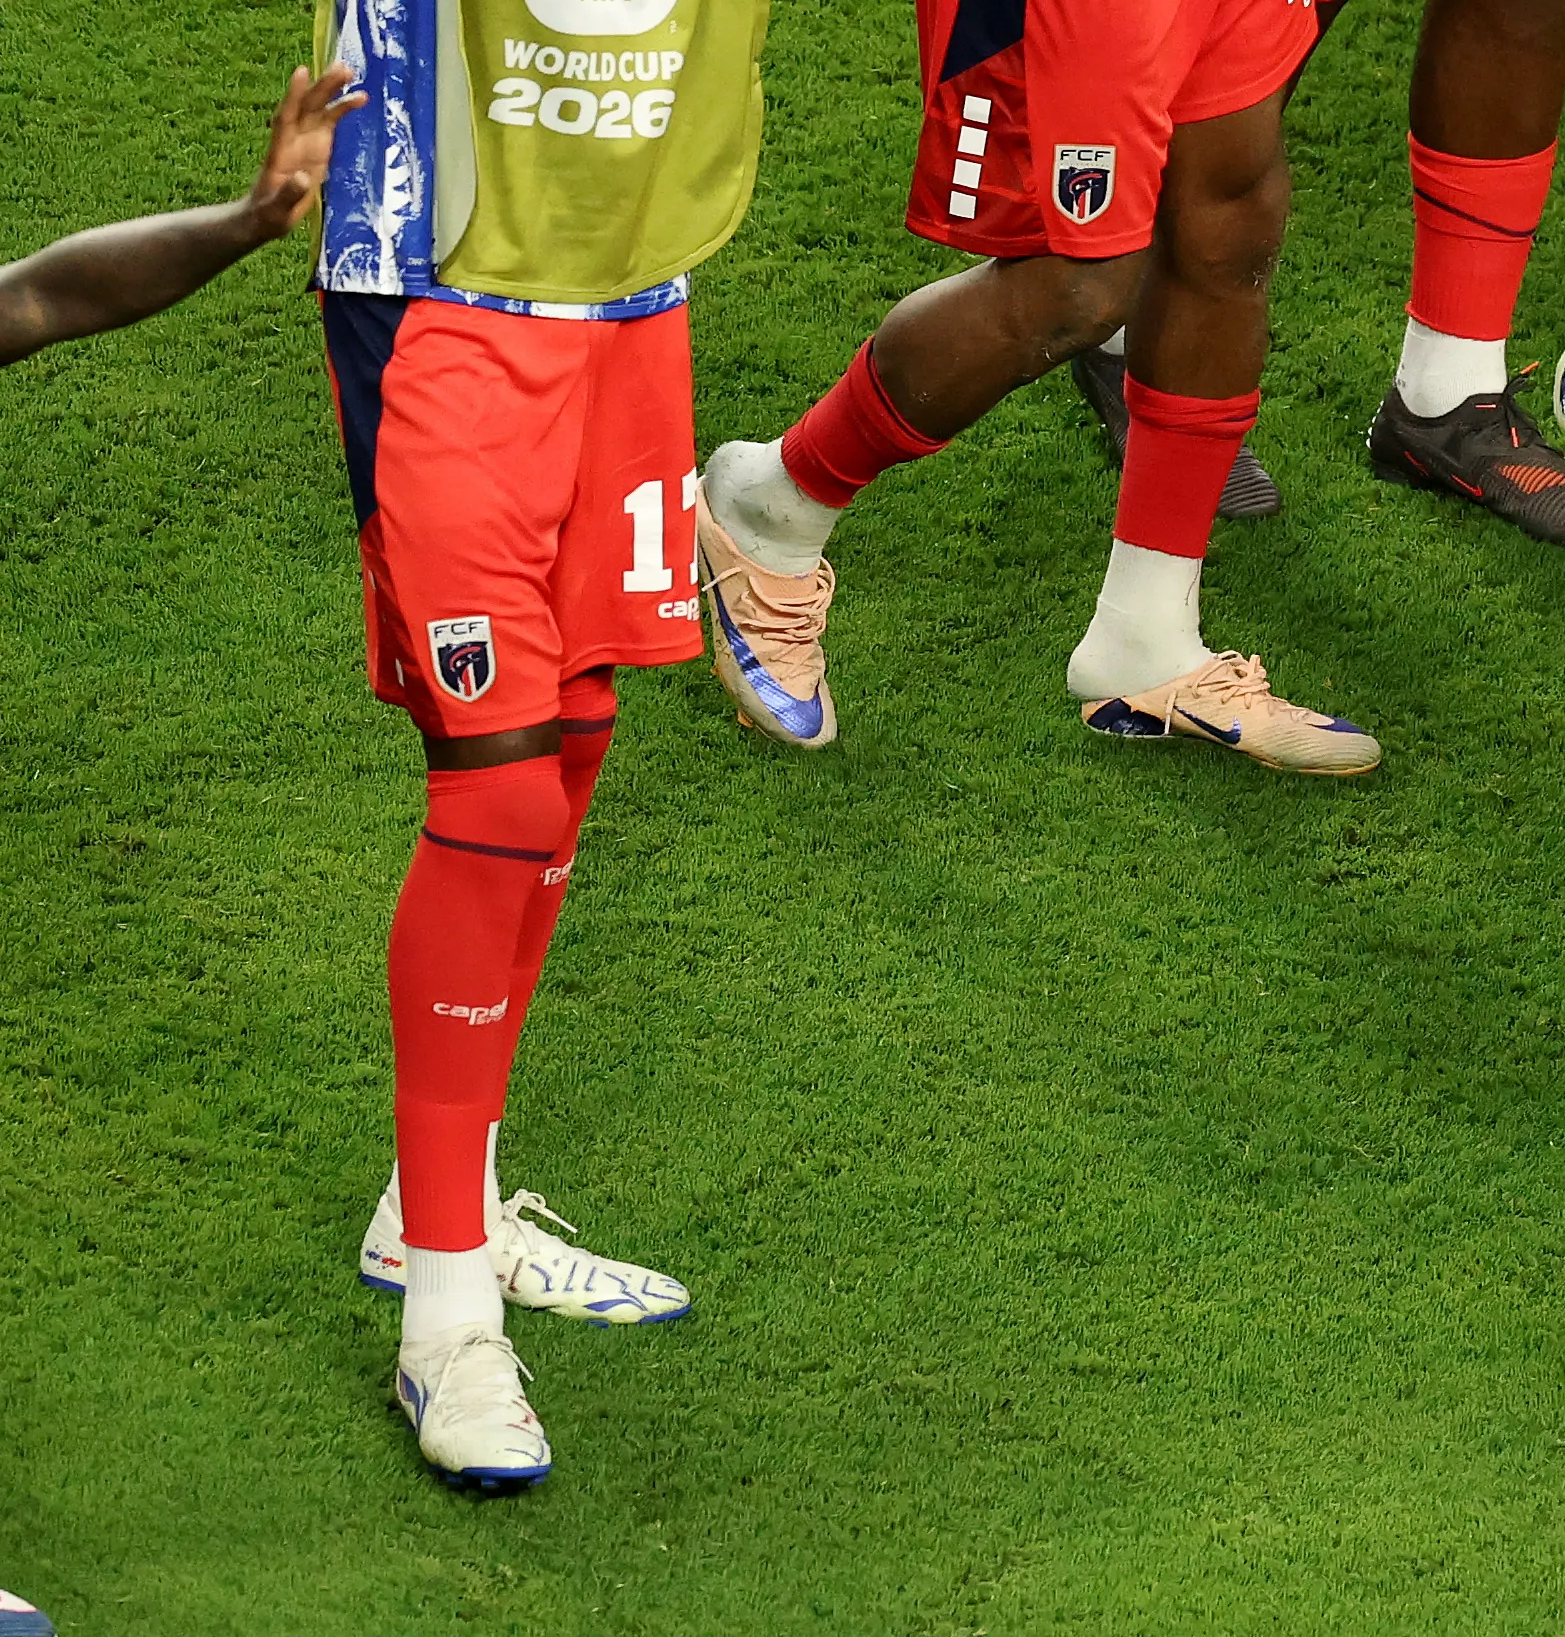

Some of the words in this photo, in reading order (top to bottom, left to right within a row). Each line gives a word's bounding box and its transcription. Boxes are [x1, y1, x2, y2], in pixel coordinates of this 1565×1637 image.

[504, 40, 613, 82] WORLD
[618, 51, 685, 82] CUP
[487, 77, 675, 139] 2026
[1060, 149, 1111, 162] FCF
[434, 621, 484, 639] FCF
